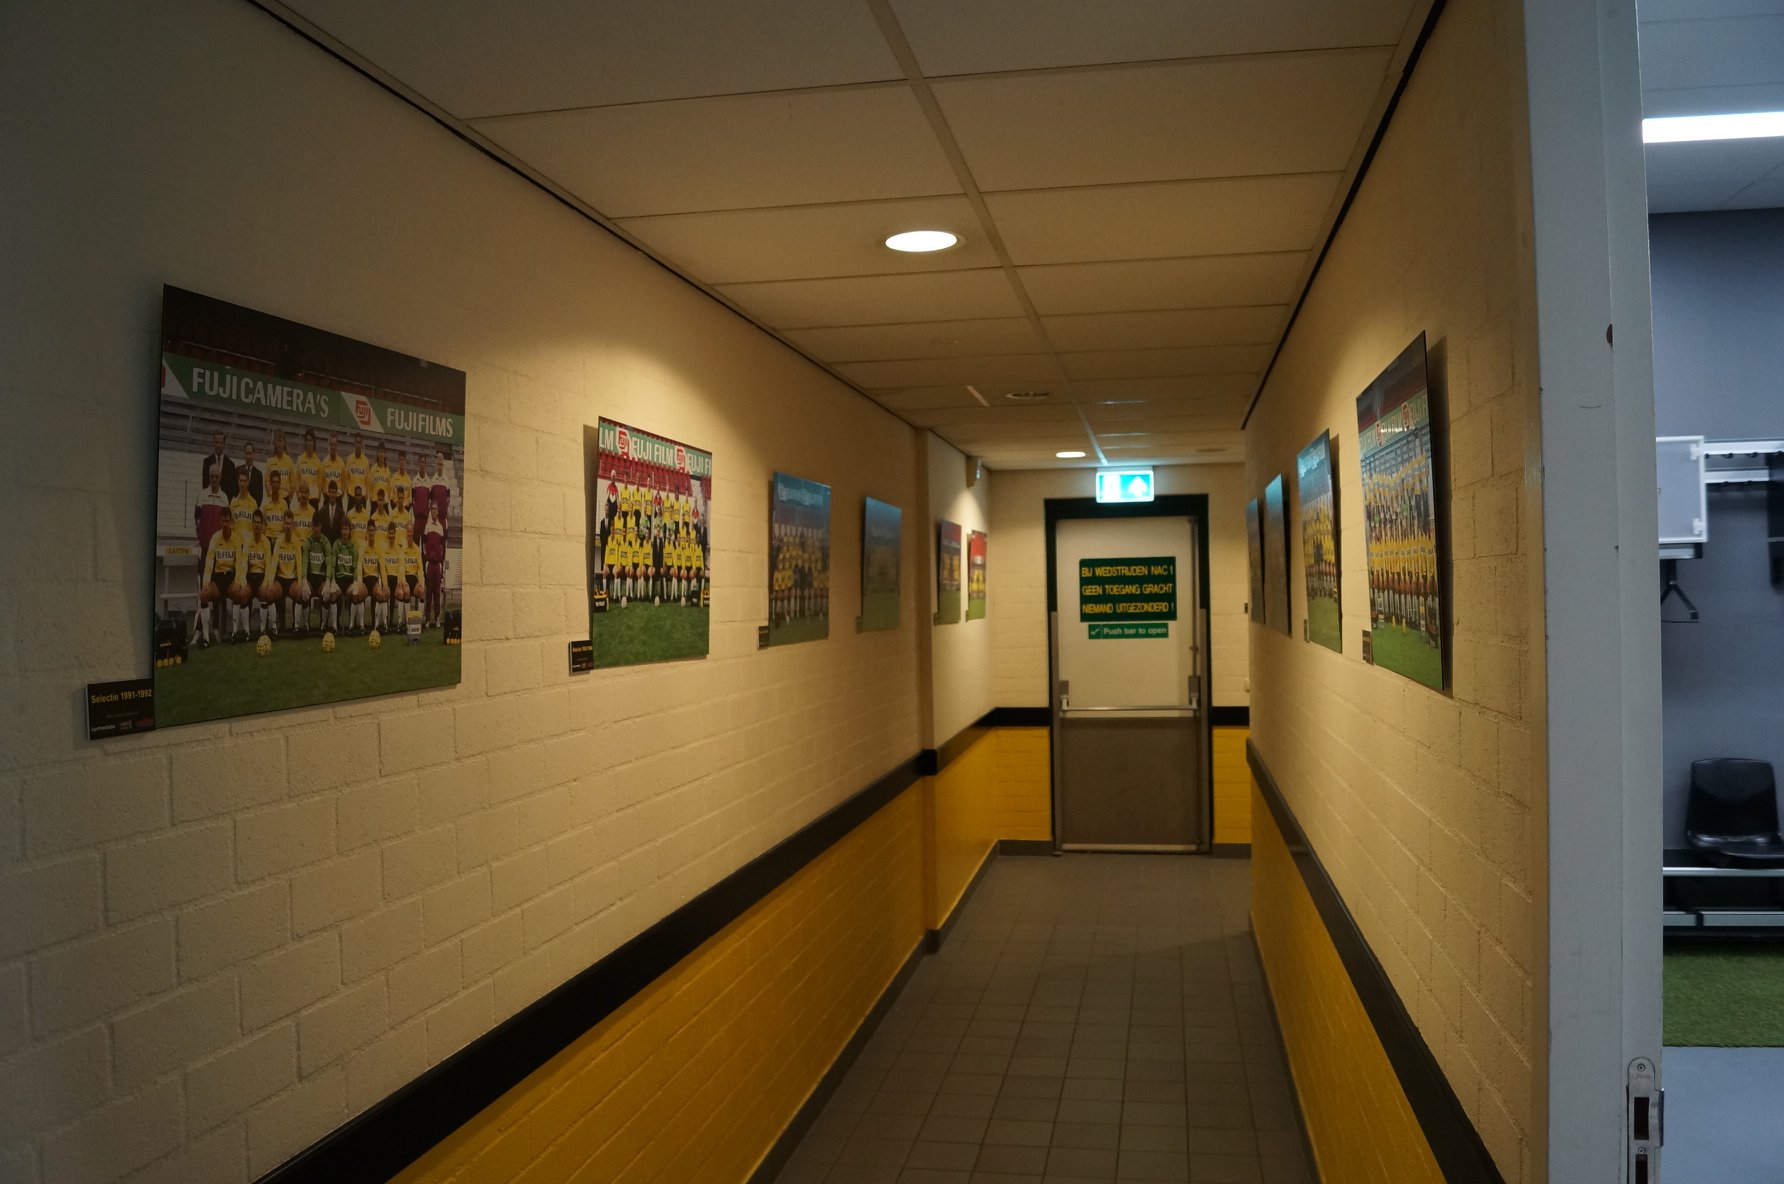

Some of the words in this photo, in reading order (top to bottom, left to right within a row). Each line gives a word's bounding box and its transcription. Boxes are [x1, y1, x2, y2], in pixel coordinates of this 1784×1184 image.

[654, 444, 673, 466] FILM
[1095, 566, 1148, 576] WEDSTRIJDEN
[1151, 565, 1168, 575] NAC
[1082, 585, 1103, 595] GEEN
[1104, 584, 1140, 595] TOEGANG
[1142, 583, 1173, 594] GRACHT
[1082, 603, 1114, 614] NIEMAND
[1116, 602, 1169, 613] UITGEZONDERD
[1103, 627, 1122, 635] Push
[1124, 627, 1137, 635] bar
[1138, 627, 1146, 635] to
[1148, 627, 1167, 636] open
[121, 688, 153, 700] 1991-1992
